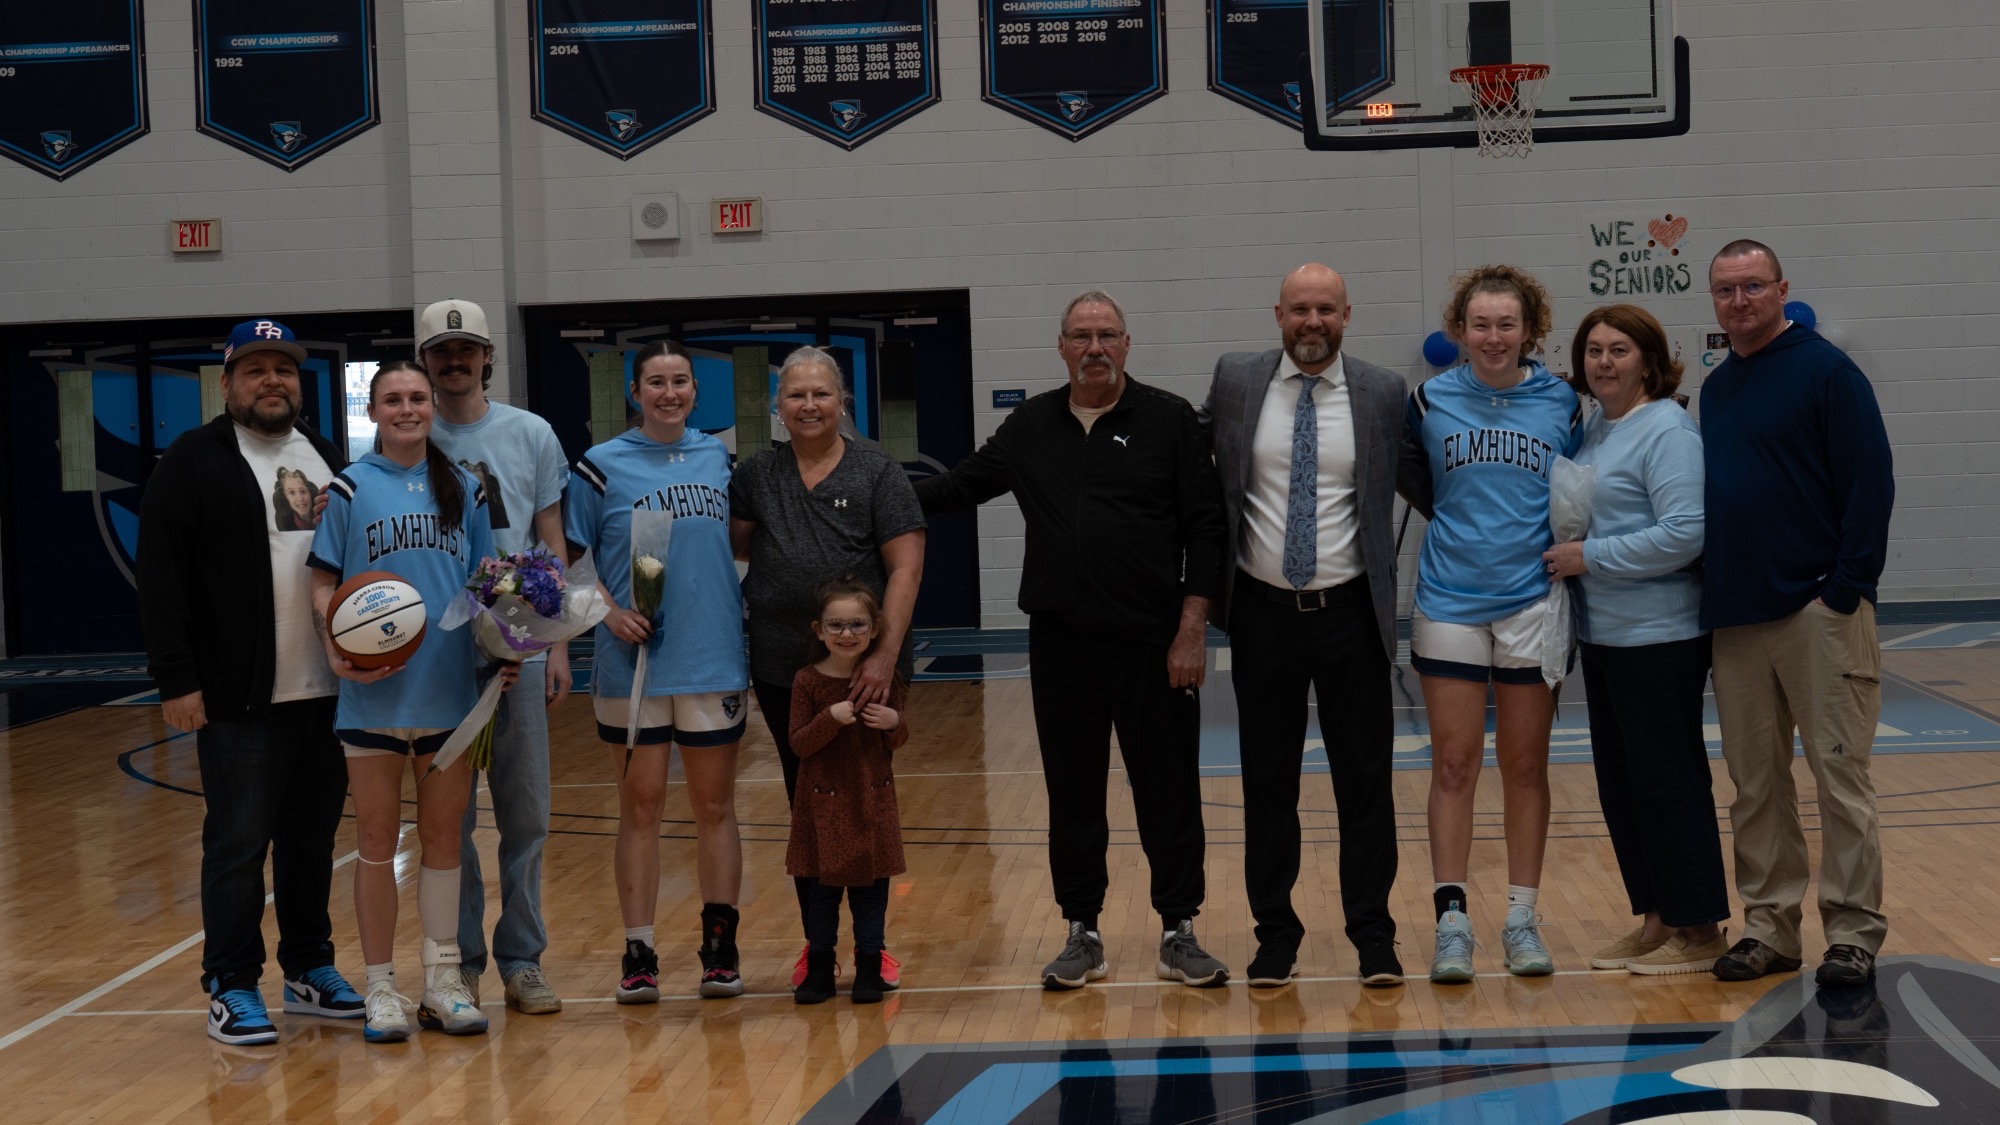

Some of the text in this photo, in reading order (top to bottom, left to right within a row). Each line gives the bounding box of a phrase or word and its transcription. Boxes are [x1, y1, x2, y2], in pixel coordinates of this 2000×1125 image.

[1003, 1, 1088, 11] CHAMPIONSHIP
[1226, 12, 1258, 22] 2025
[571, 26, 633, 34] CHAMPIONSHIP
[635, 23, 697, 32] APPEARANCES
[795, 28, 858, 36] CHAMPIONSHIP
[860, 25, 922, 34] APPEARANCES
[999, 19, 1143, 33] 2005 2008 2009 2011
[259, 35, 338, 45] CHAMPIONSHIPS
[1001, 32, 1106, 45] 2012 2013 2016
[5, 47, 67, 56] CHAMPIONSHIP
[69, 44, 130, 53] APPEARANCES
[550, 45, 579, 55] 2014
[772, 42, 918, 56] 1982 1983 1984 1985 1986
[215, 58, 243, 68] 1992
[773, 52, 921, 65] 1987 1988 1992 1998 2000
[772, 61, 921, 74] 2001 2002 2003 2004 2005
[774, 70, 919, 83] 2011 2012 2013 2014 2015
[773, 85, 796, 93] 2016
[720, 203, 752, 228] EXIT
[180, 223, 210, 247] EXIT
[1590, 221, 1634, 246] WE
[1620, 250, 1651, 263] OUR
[1589, 260, 1690, 296] SENIORS
[1444, 429, 1552, 479] ELMHURST
[365, 591, 385, 604] 1000
[358, 602, 379, 616] CAREER
